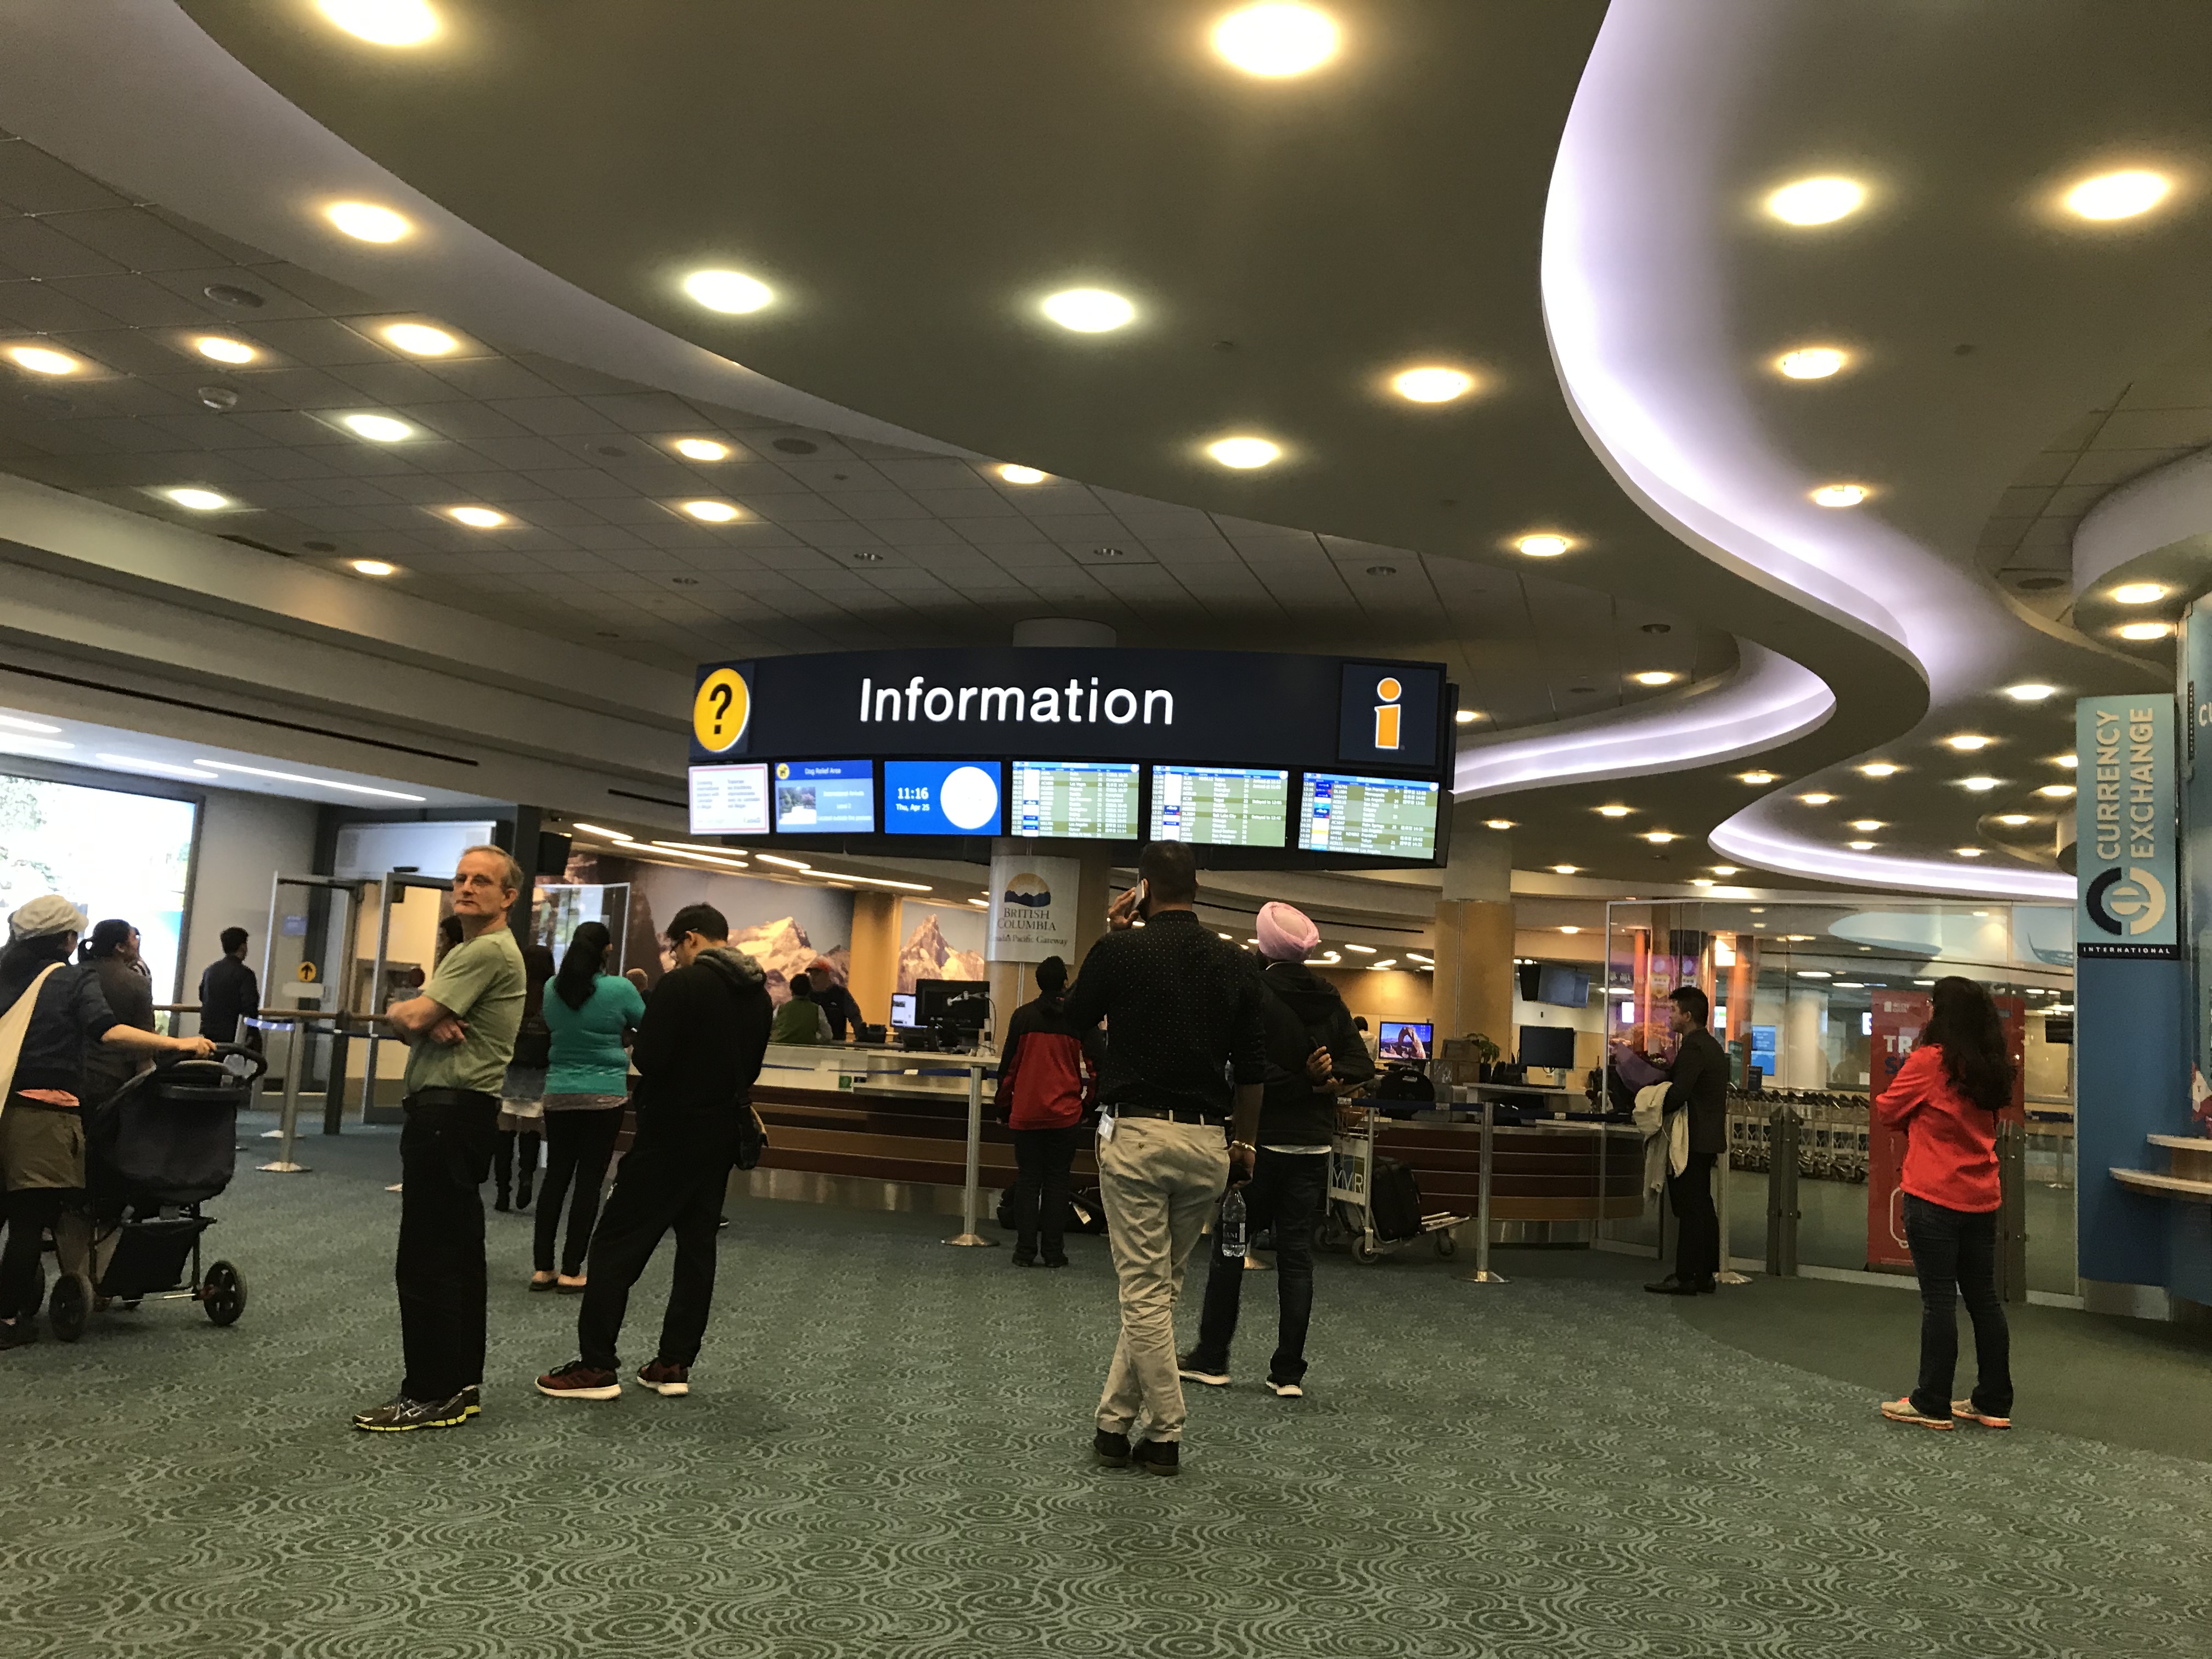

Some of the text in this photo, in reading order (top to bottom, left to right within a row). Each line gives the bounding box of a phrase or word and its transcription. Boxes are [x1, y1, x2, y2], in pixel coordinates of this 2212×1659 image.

[860, 676, 1173, 725] Information
[2096, 710, 2121, 860] CURRENCY
[2129, 708, 2154, 858] EXCHANGE
[898, 787, 929, 799] 11:16
[895, 803, 909, 811] Thu,
[1004, 907, 1049, 919] BRITISH
[997, 918, 1057, 931] COLUMBIA
[1013, 934, 1034, 943] Pacific
